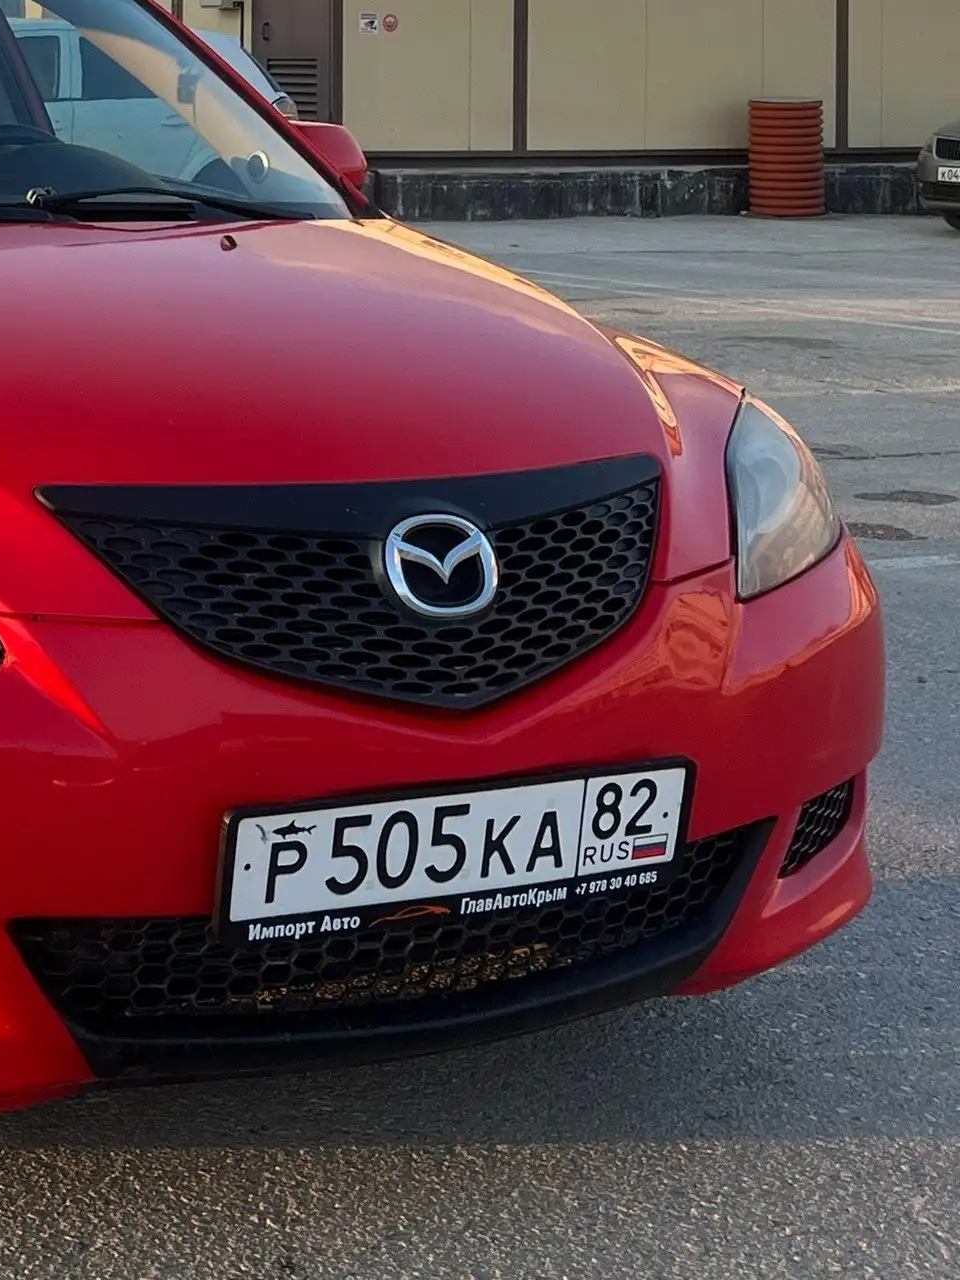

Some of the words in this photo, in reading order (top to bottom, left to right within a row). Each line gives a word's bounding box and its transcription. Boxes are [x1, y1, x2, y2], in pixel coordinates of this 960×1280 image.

[591, 778, 658, 840] 82
[582, 840, 629, 866] RUS
[574, 883, 588, 896] +7
[589, 879, 607, 894] 978
[609, 877, 623, 891] 30
[624, 874, 637, 887] 40
[639, 871, 658, 885] 685
[460, 886, 568, 914] ГлавАвтоКрым
[248, 920, 316, 941] Импорт
[320, 915, 361, 933] Авто
